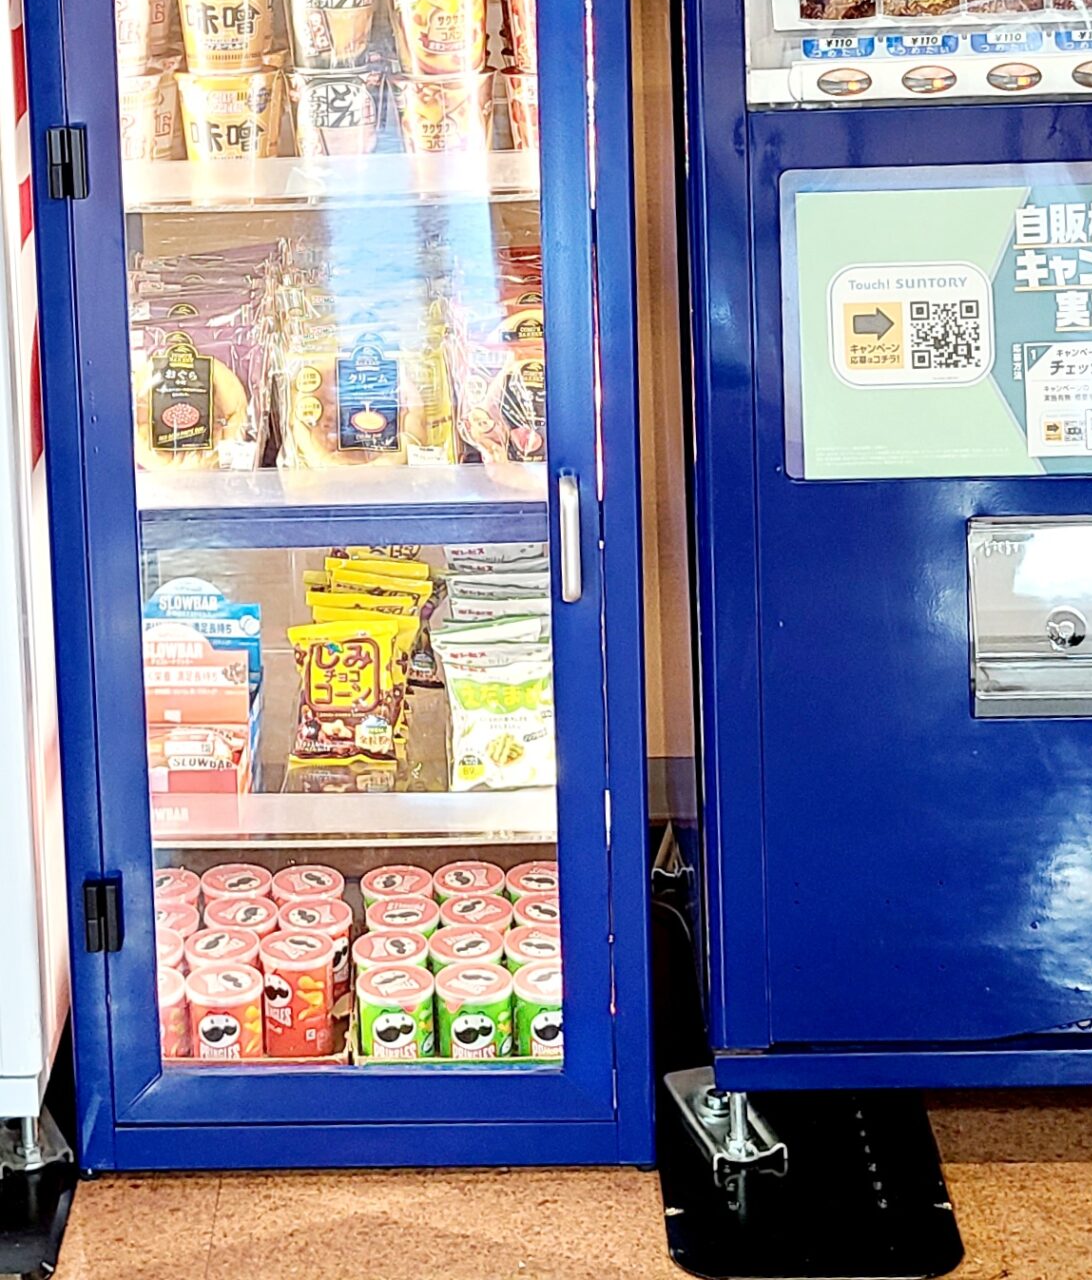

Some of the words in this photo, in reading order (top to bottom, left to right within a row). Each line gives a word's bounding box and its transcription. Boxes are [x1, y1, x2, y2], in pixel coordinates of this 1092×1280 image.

[826, 39, 853, 48] ¥110
[912, 36, 938, 45] ¥110
[995, 33, 1022, 42] ¥110
[848, 278, 890, 291] Touch!
[896, 276, 968, 289] SUNTORY
[850, 344, 900, 356] キャンペーン
[850, 354, 901, 366] 応募はコチラ!
[347, 373, 388, 385] クリーム
[159, 595, 218, 612] SLOWBAR
[314, 643, 373, 670] しみ
[324, 669, 361, 684] チョコ
[314, 683, 372, 704] コーン
